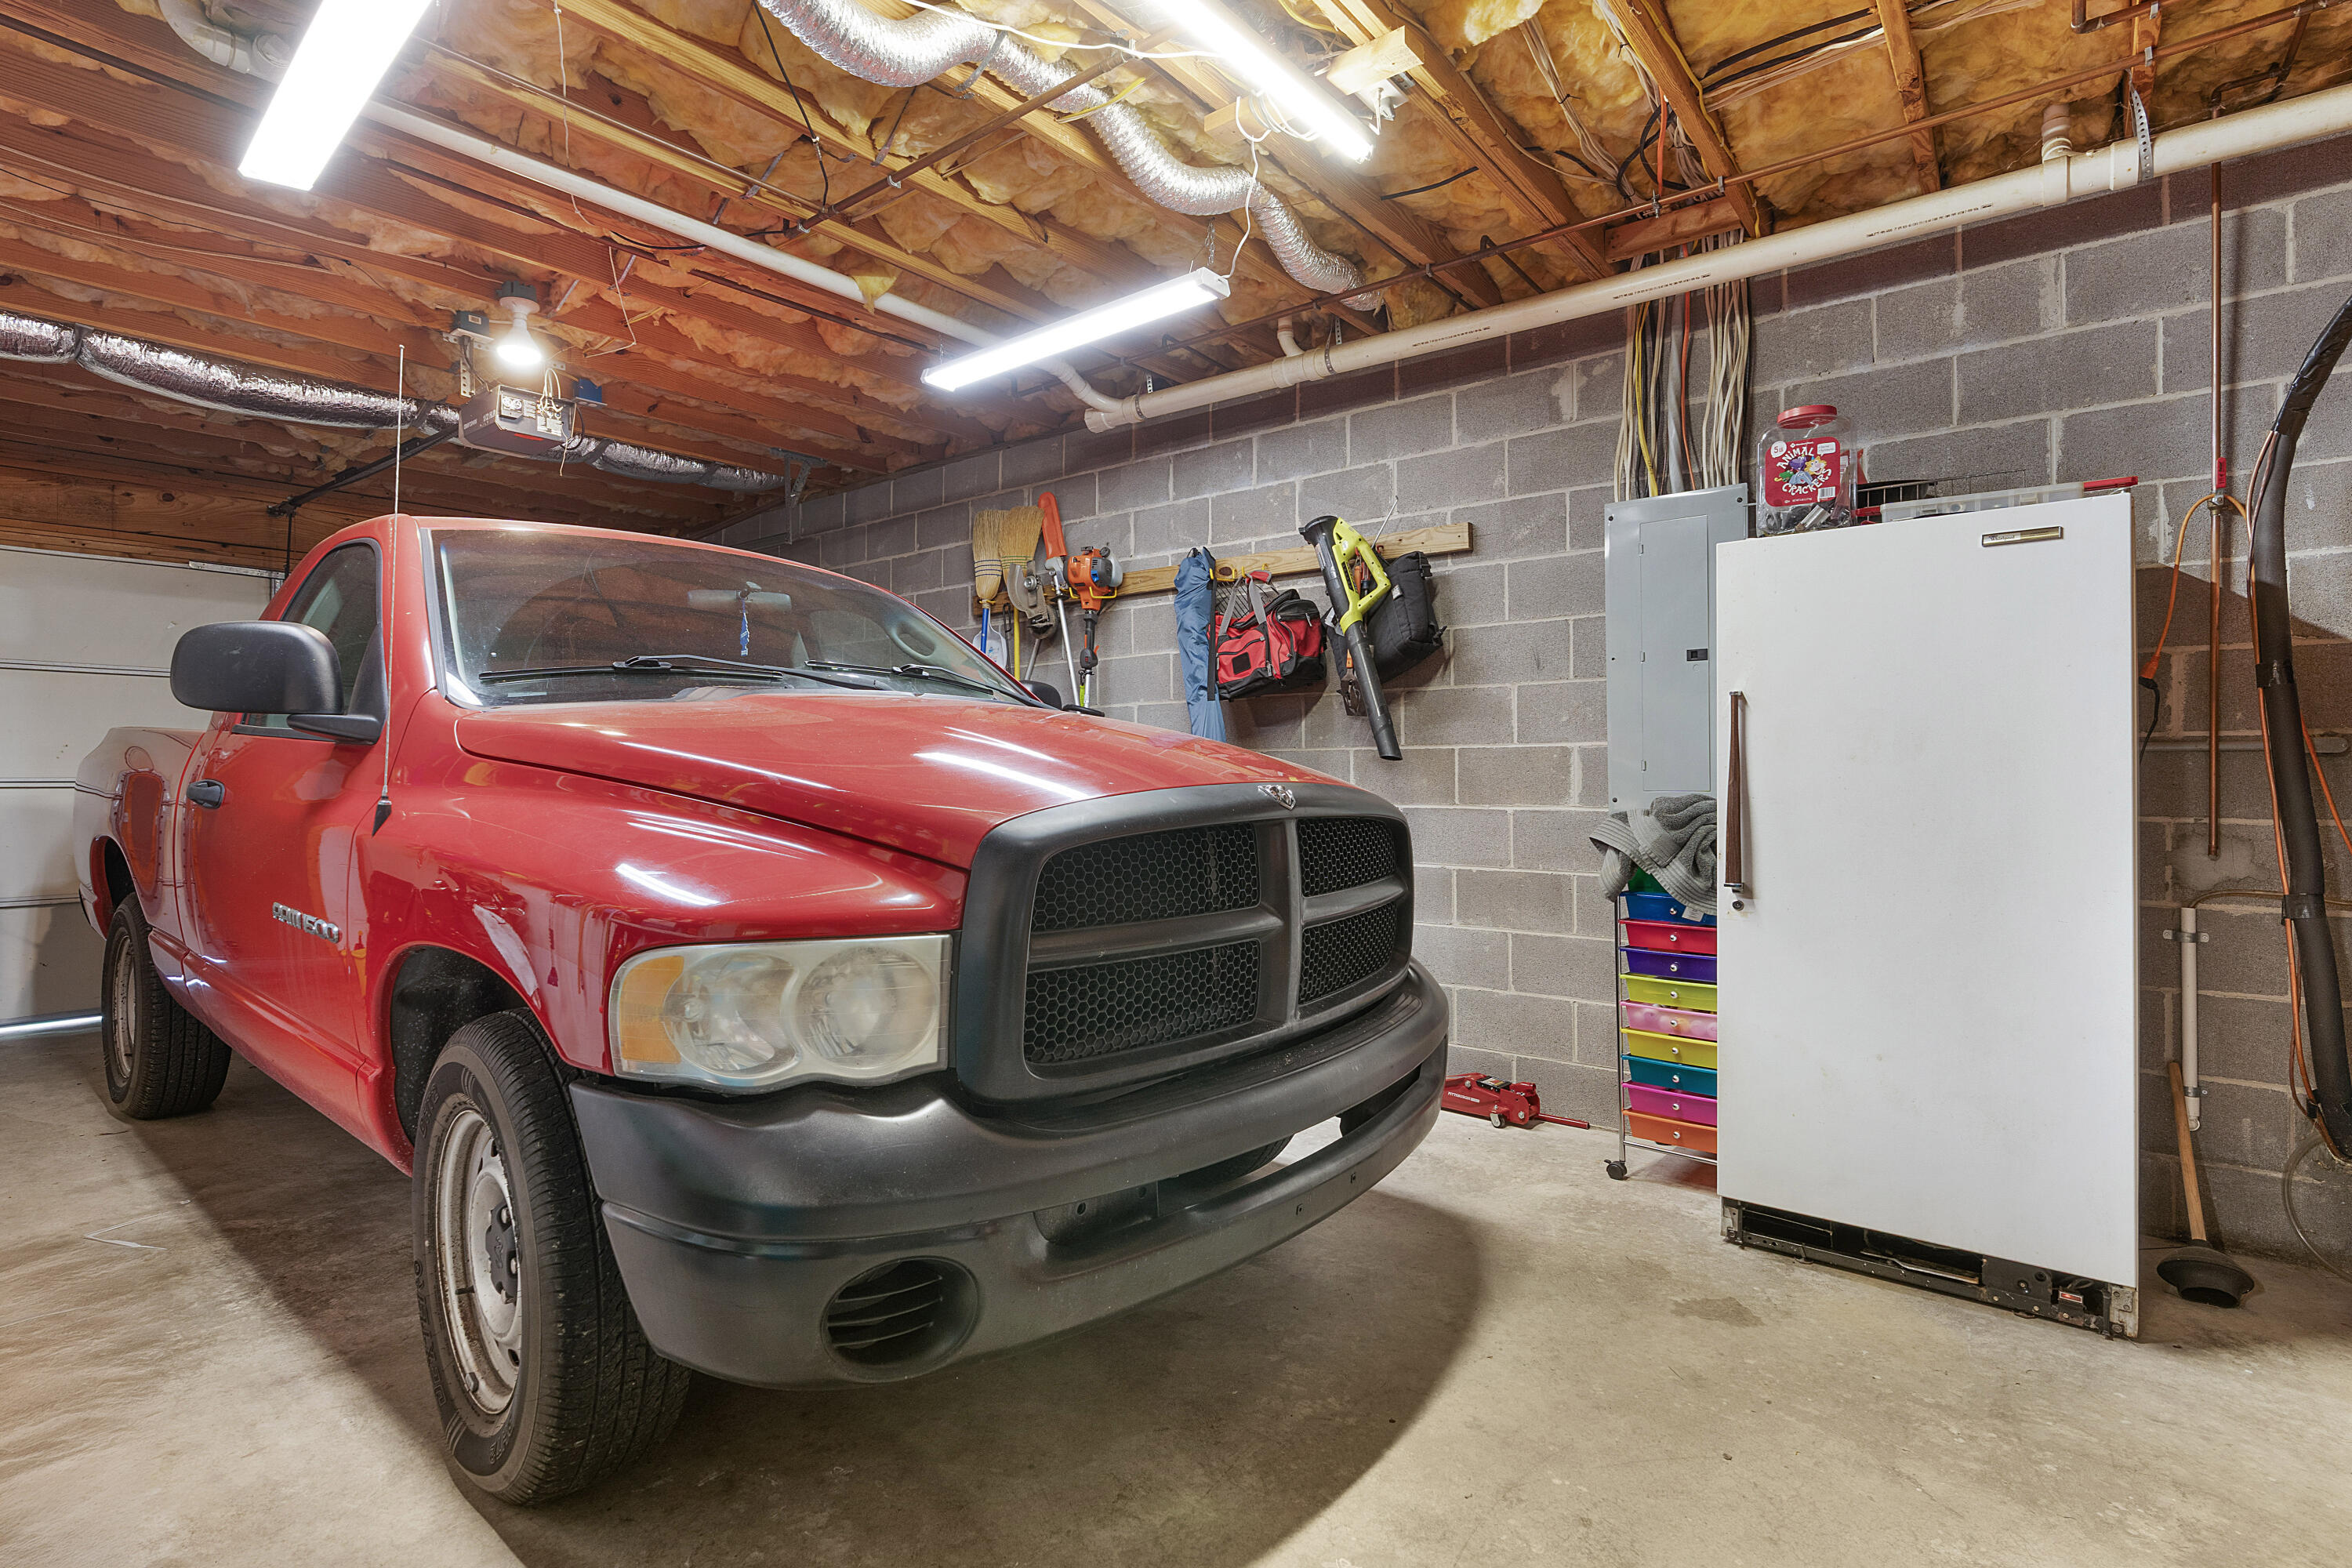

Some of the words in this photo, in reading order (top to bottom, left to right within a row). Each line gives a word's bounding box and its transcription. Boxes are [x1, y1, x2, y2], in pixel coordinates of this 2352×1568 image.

[1776, 446, 1815, 469] ANIMAL
[1782, 468, 1832, 495] CRACKERS
[272, 902, 302, 931] RAM
